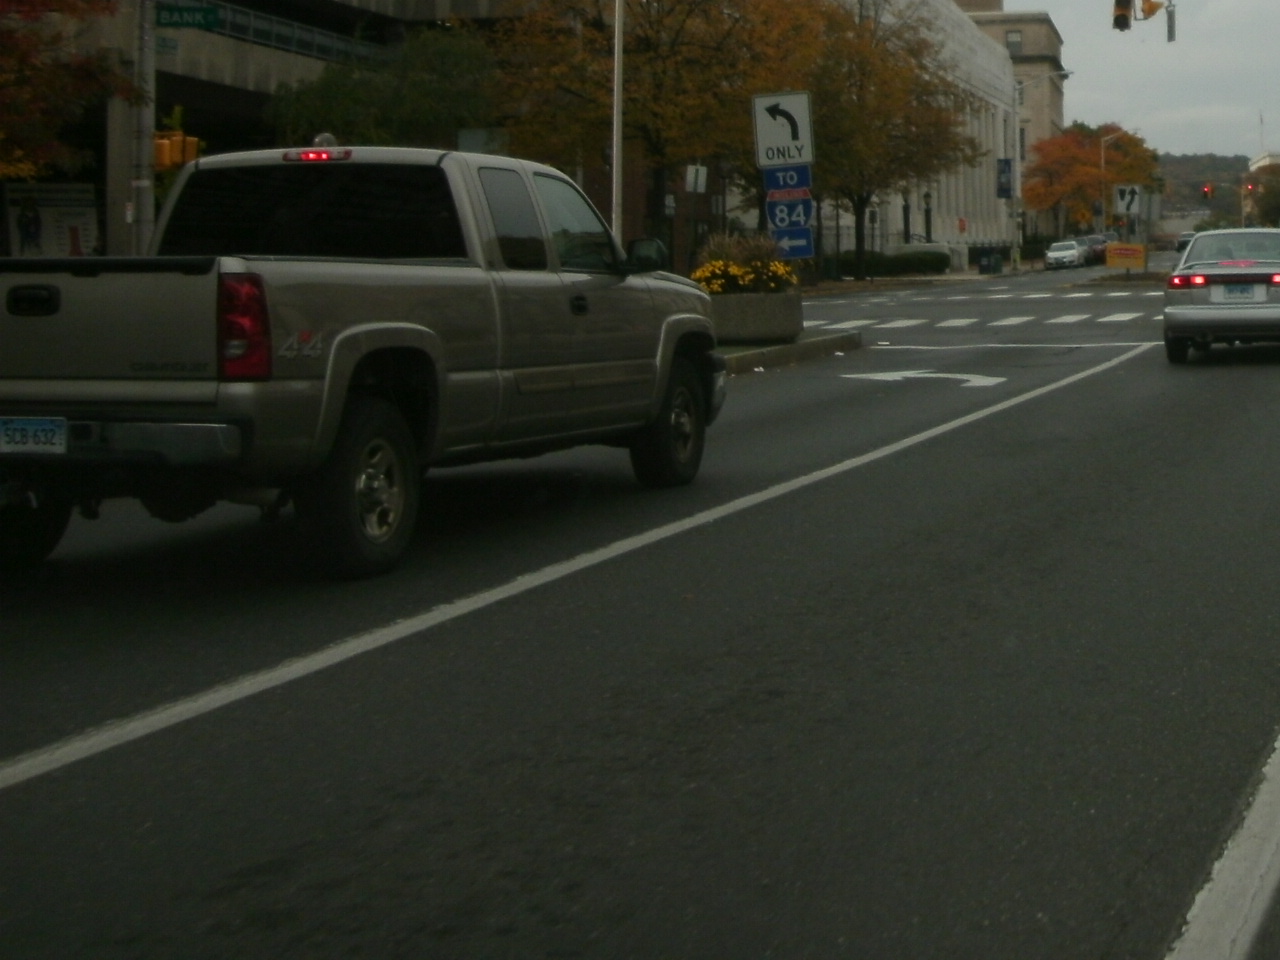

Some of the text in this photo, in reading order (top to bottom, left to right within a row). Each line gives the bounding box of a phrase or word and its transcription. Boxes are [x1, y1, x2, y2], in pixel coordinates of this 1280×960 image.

[159, 10, 205, 24] BANK
[766, 144, 805, 161] ONLY
[776, 170, 798, 186] TO
[775, 203, 807, 228] 84
